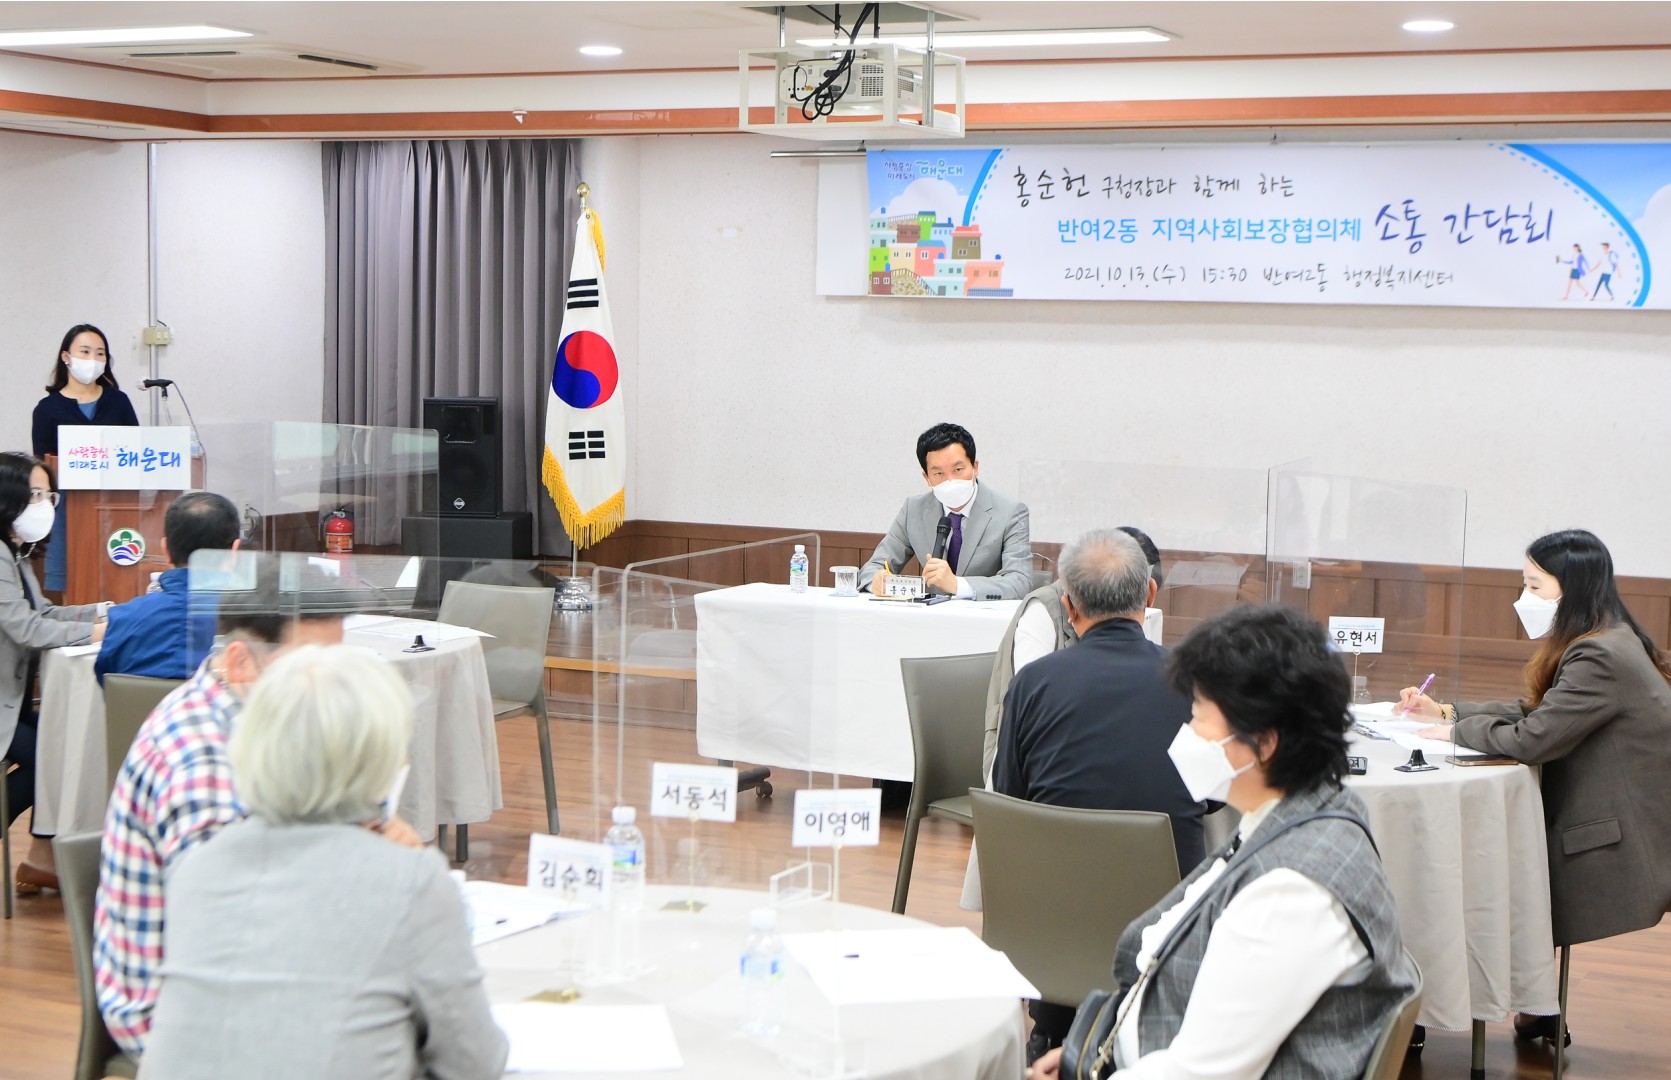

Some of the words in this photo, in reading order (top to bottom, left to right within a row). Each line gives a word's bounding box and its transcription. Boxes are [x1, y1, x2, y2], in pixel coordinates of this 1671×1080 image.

[915, 159, 964, 181] 해운대
[1013, 165, 1091, 208] 홍순헌
[1101, 176, 1176, 200] 구청장과
[1193, 176, 1241, 200] 함께
[1257, 173, 1294, 198] 하는
[1057, 218, 1139, 246] 반여2동
[1151, 216, 1361, 245] 지역사회보장협의체
[1374, 199, 1428, 255] 소통
[1442, 201, 1554, 246] 간담회
[1201, 266, 1248, 284] 15:30
[1262, 262, 1330, 293] 반여2동
[1343, 266, 1455, 293] 행정복지센터
[68, 446, 109, 459] 사람중심
[115, 446, 181, 472] 해운대
[69, 460, 109, 470] 미래도시
[1334, 630, 1377, 647] 유현서
[661, 785, 728, 812] 서동석
[804, 811, 870, 837] 이영애
